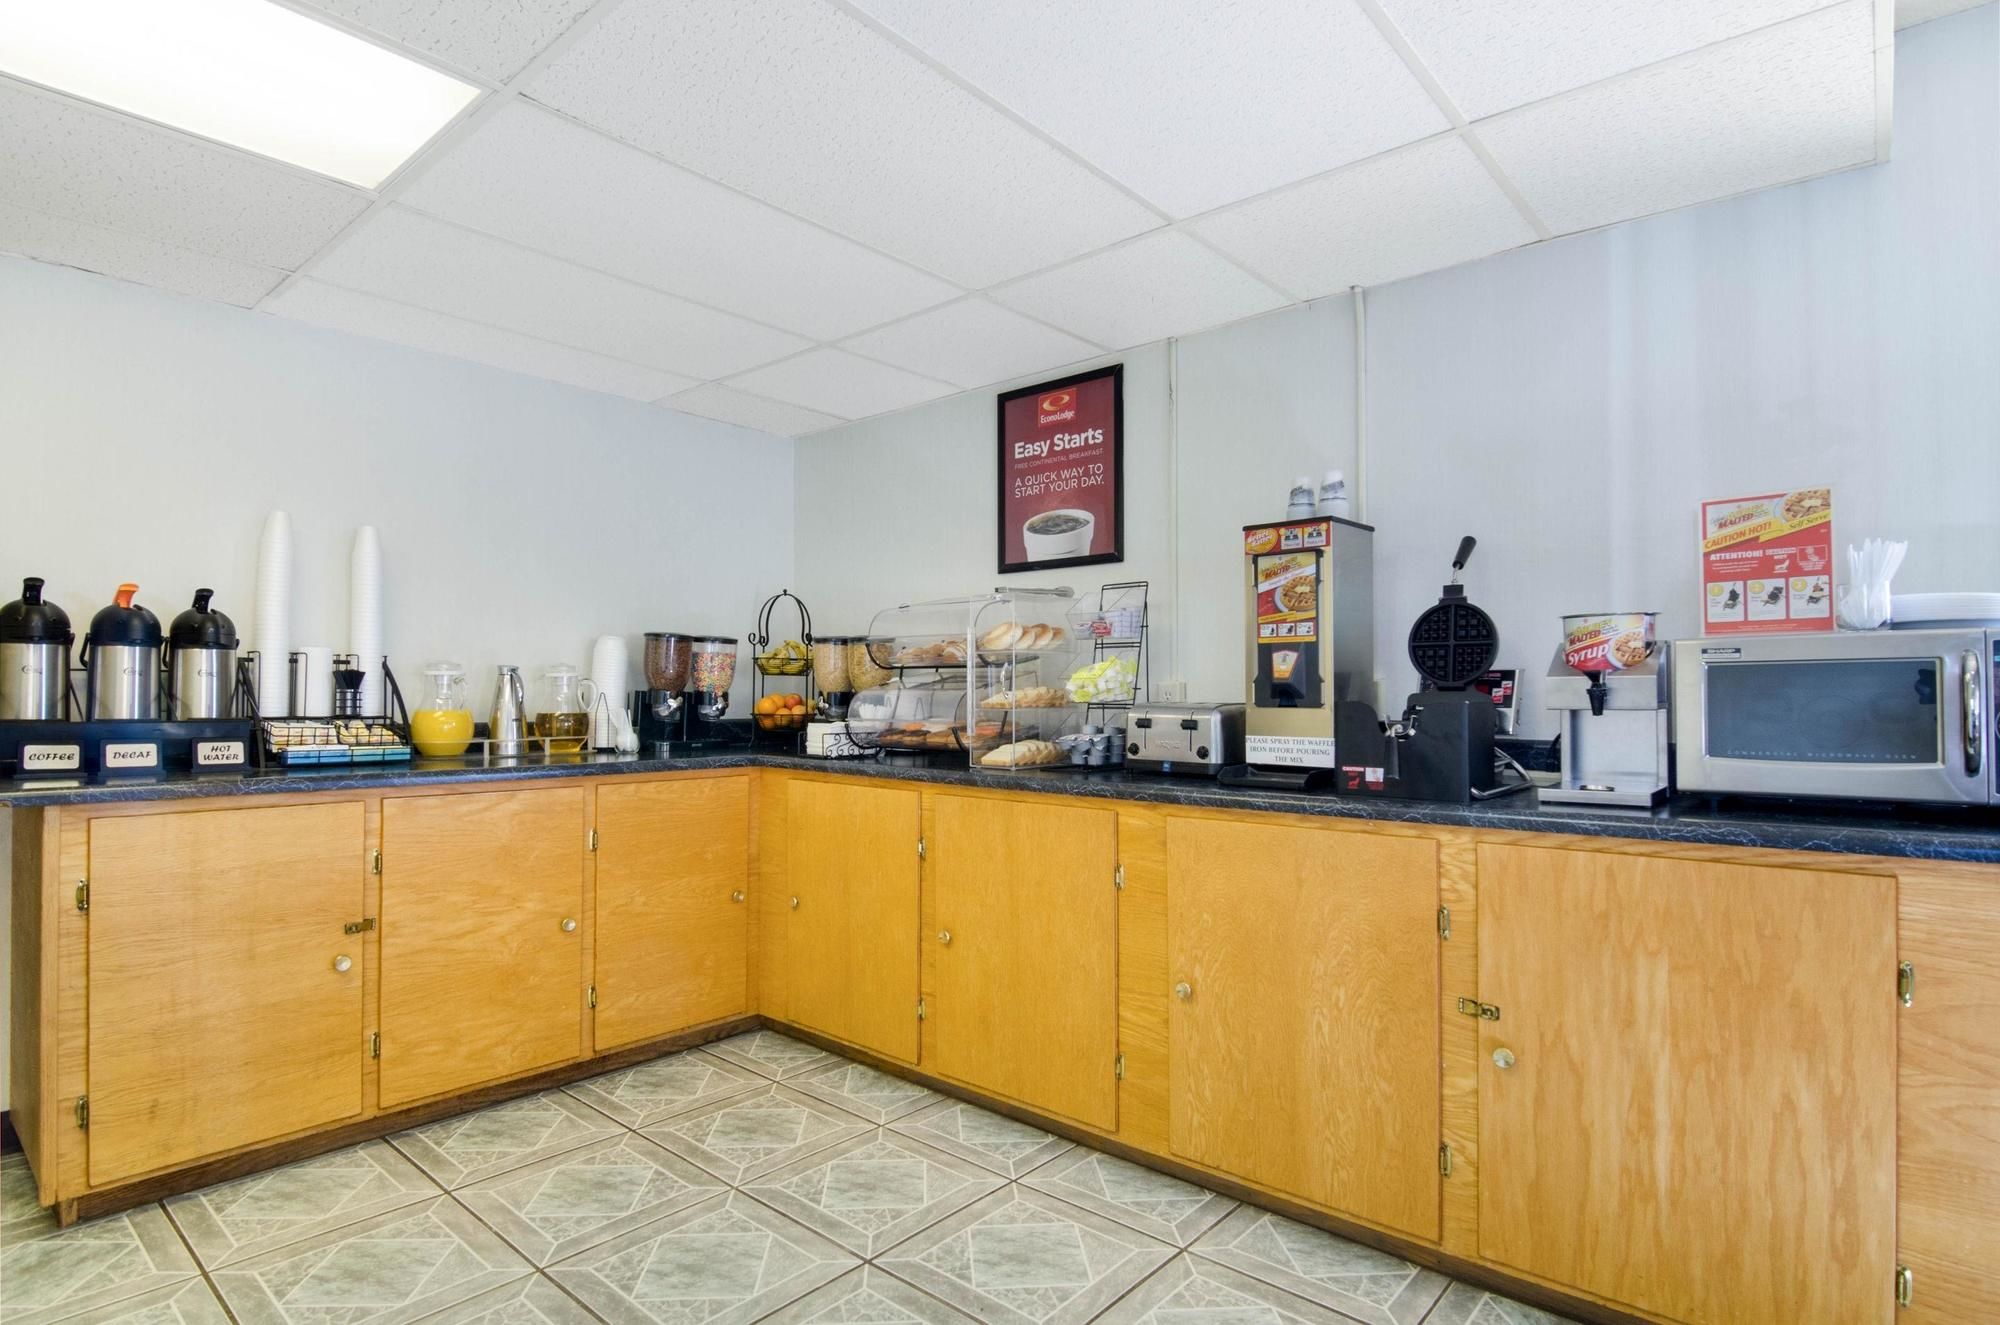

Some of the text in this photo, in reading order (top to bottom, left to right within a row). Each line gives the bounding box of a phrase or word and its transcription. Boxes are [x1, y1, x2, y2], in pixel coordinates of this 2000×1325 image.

[1014, 427, 1104, 459] Easy Starts
[1014, 448, 1103, 470] FREE CONTINENTAL BREAKFAST
[1015, 463, 1104, 488] A QUICK WAY TO
[1015, 474, 1104, 498] START YOUR DAY.
[1704, 521, 1772, 549] CAUTION HOT!
[1709, 549, 1764, 561] ATTENTION!
[1308, 739, 1335, 747] WAFFLE
[210, 745, 231, 753] HOT
[1268, 746, 1294, 754] BEFORE
[1296, 748, 1330, 756] POURING
[28, 752, 75, 762] COFFEE
[112, 750, 152, 760] DECAF
[203, 753, 240, 762] WATER
